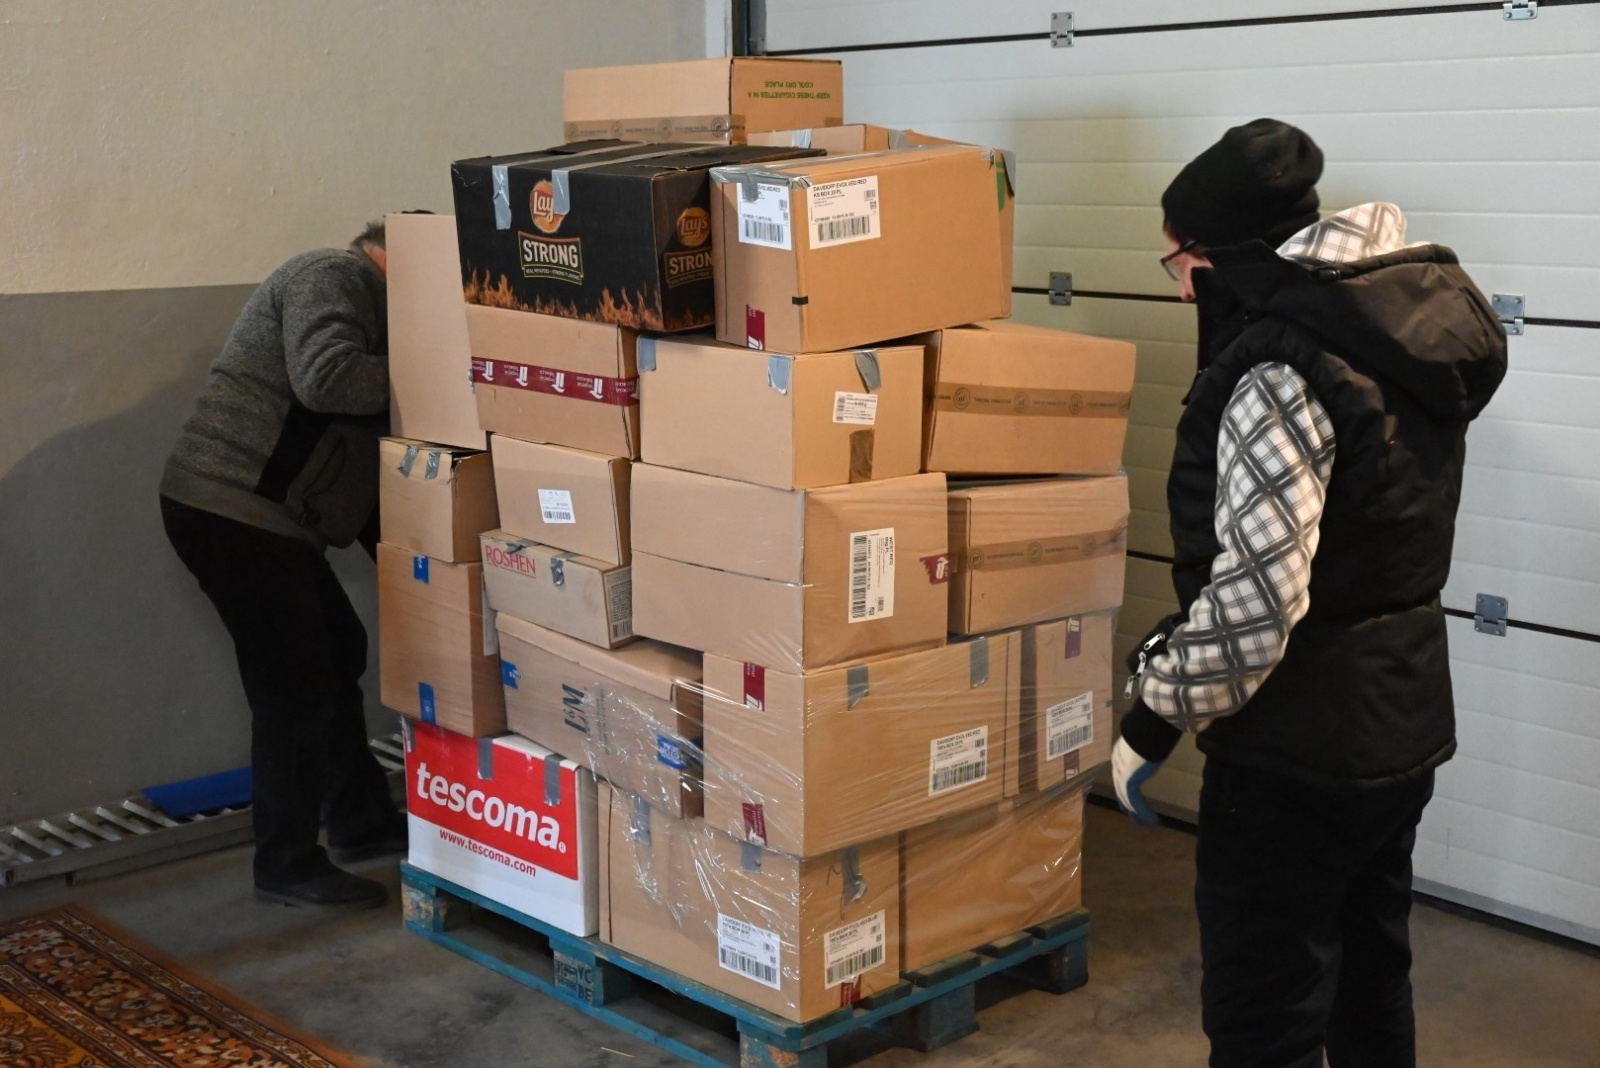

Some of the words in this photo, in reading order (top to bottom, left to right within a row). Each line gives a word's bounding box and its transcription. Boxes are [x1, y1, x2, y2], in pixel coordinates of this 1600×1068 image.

[760, 91, 796, 99] CIGARETTES
[765, 80, 783, 88] PLACE
[813, 183, 836, 192] DAVIDOFF
[680, 217, 708, 238] Lay's
[522, 239, 578, 268] STRONG
[669, 251, 713, 275] STRON
[485, 545, 536, 575] ROSHEN
[562, 683, 592, 738] L&M
[416, 762, 560, 850] tescoma
[439, 829, 537, 877] www.tescoma.com
